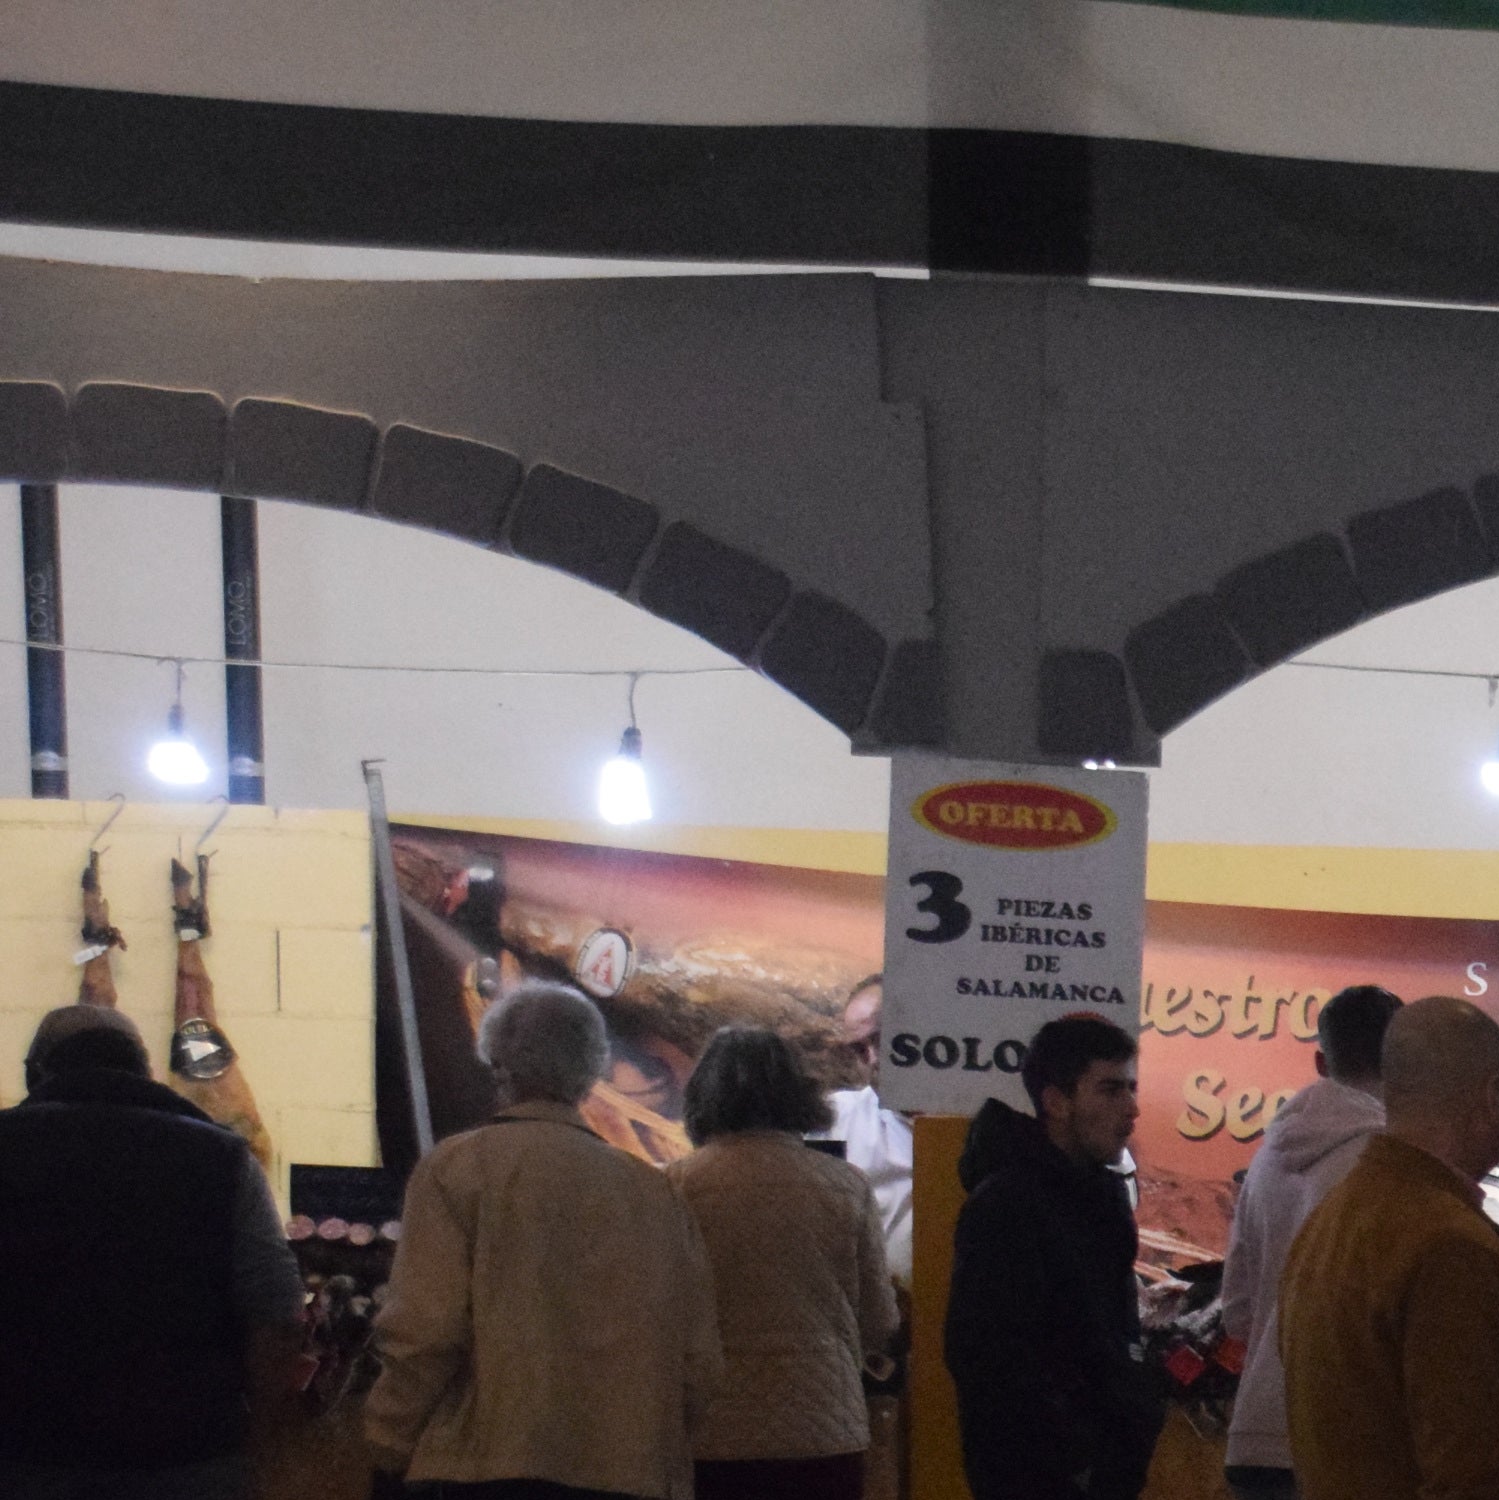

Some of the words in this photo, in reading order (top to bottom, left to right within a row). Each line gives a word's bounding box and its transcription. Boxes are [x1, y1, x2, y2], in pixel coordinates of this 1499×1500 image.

[227, 581, 246, 645] LOMO
[938, 800, 1084, 834] OFERTA
[905, 870, 972, 944] 3
[997, 898, 1093, 921] PIEZAS
[980, 922, 1106, 949] IBÉRICAS
[1025, 954, 1061, 973] DE
[956, 977, 1126, 1005] SALAMANCA
[889, 1033, 1027, 1074] SOLO
